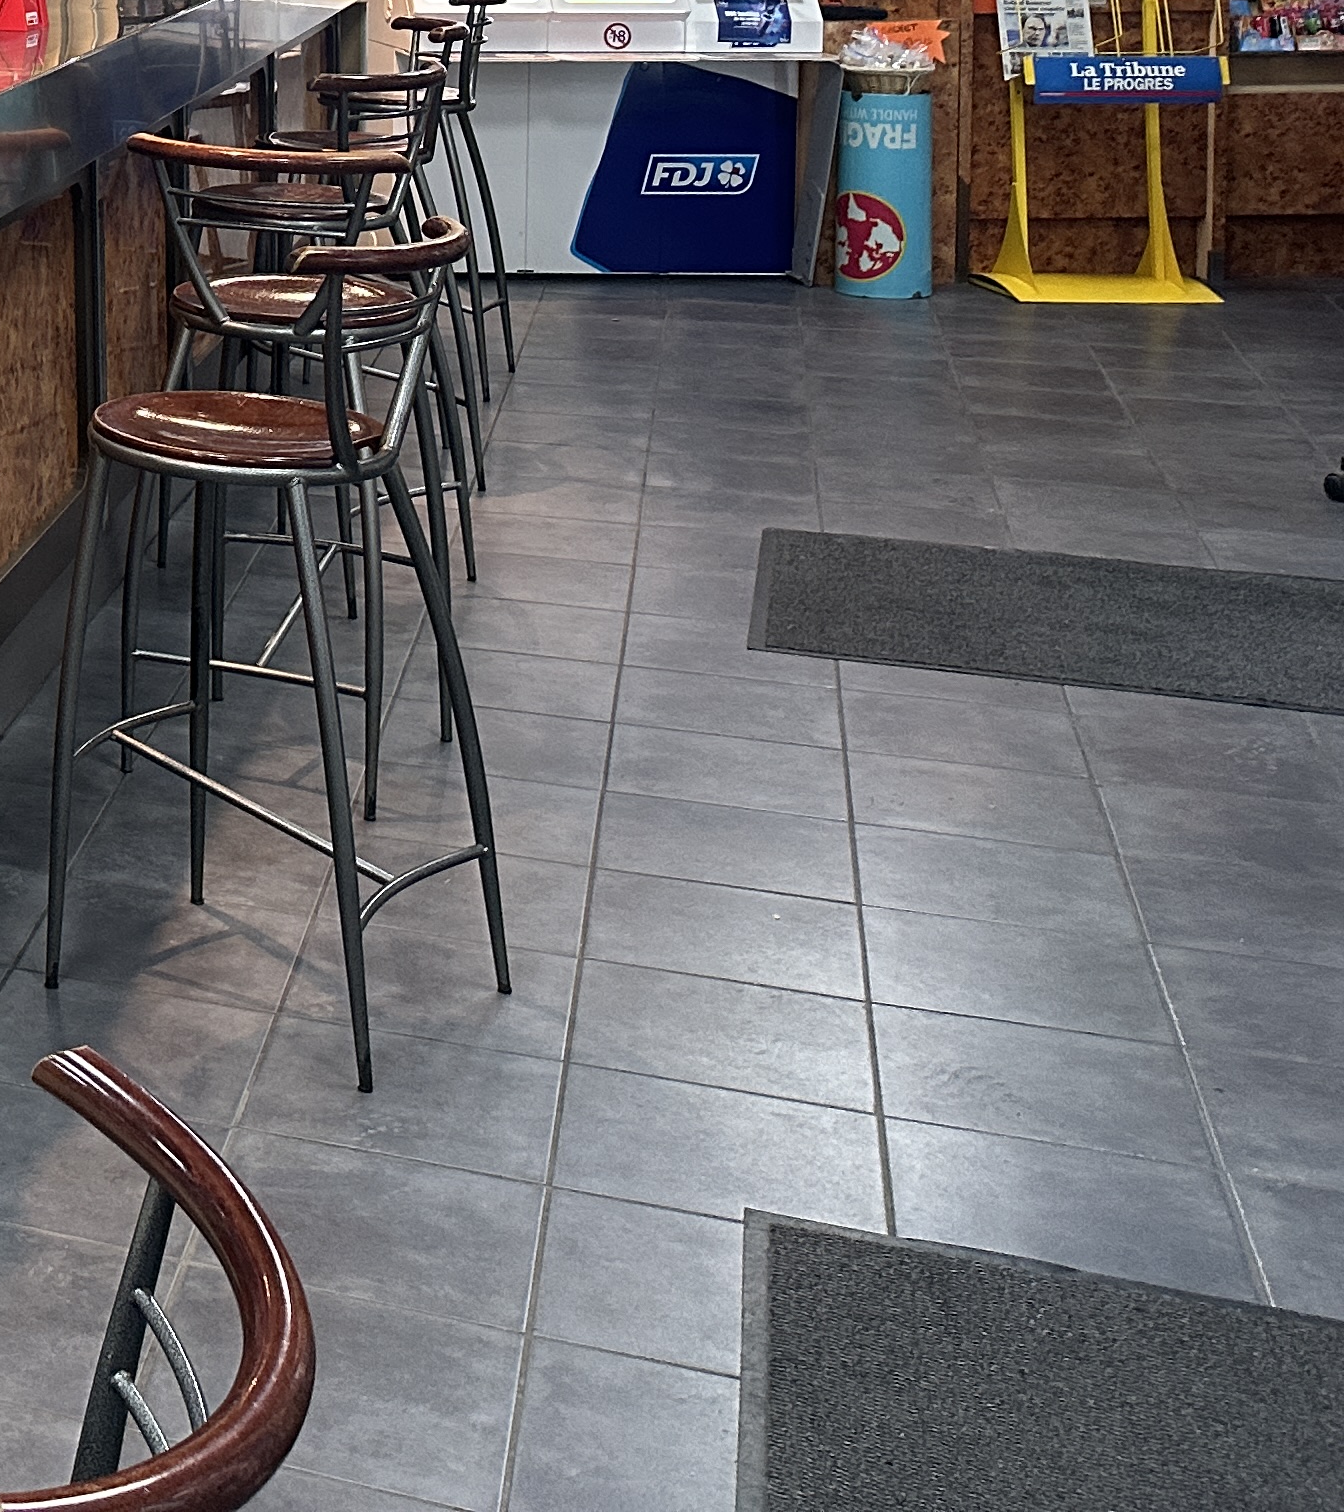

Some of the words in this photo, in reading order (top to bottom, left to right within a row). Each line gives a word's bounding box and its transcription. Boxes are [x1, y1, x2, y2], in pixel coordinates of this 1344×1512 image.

[1070, 62, 1097, 77] La
[1100, 61, 1186, 77] Tribune
[1084, 78, 1102, 91] LE
[872, 108, 918, 121] HANDLE
[651, 159, 714, 187] FDJ
